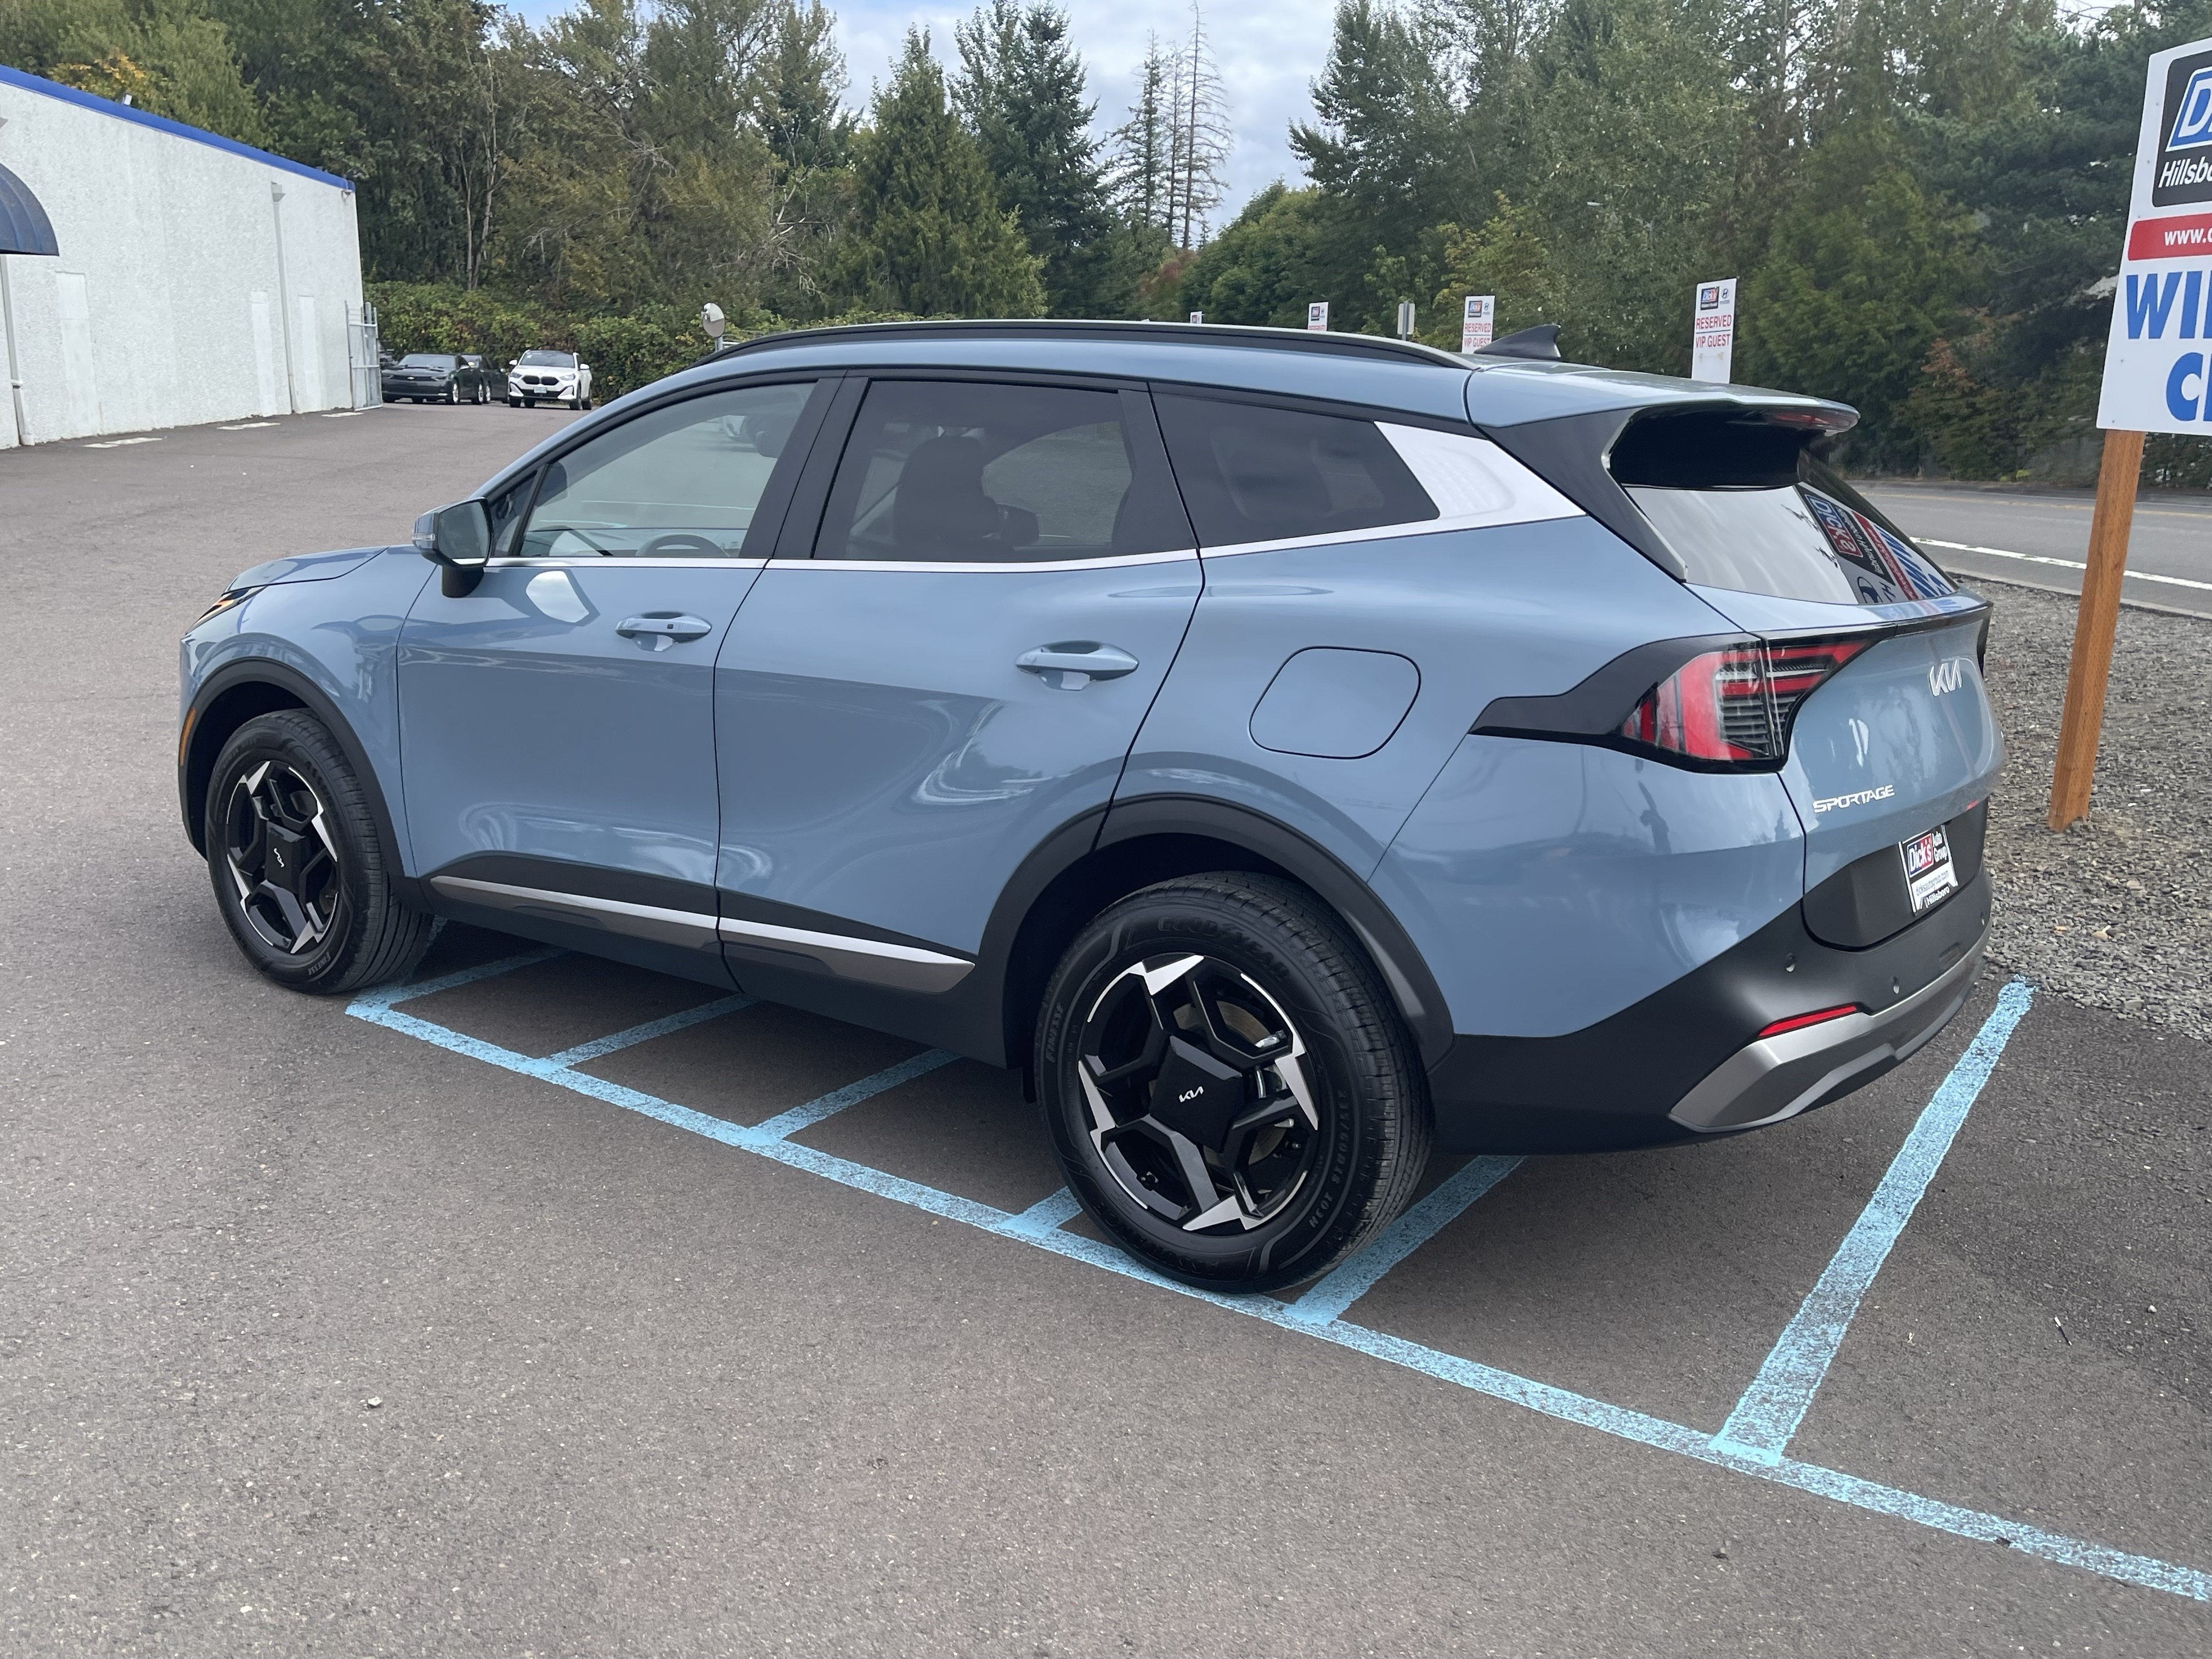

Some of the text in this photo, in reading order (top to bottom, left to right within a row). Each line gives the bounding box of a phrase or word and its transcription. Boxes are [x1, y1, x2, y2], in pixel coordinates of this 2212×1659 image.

[2178, 78, 2212, 138] D
[2126, 270, 2212, 339] WI
[1464, 323, 1491, 332] RESERVED
[1696, 314, 1732, 329] RESERVED
[1464, 337, 1472, 347] VIP
[1695, 334, 1731, 348] VIP GUEST
[1813, 785, 1895, 812] SPORTAGE
[1909, 839, 1931, 872] Dick's
[1926, 886, 1950, 905] Hillsboro
